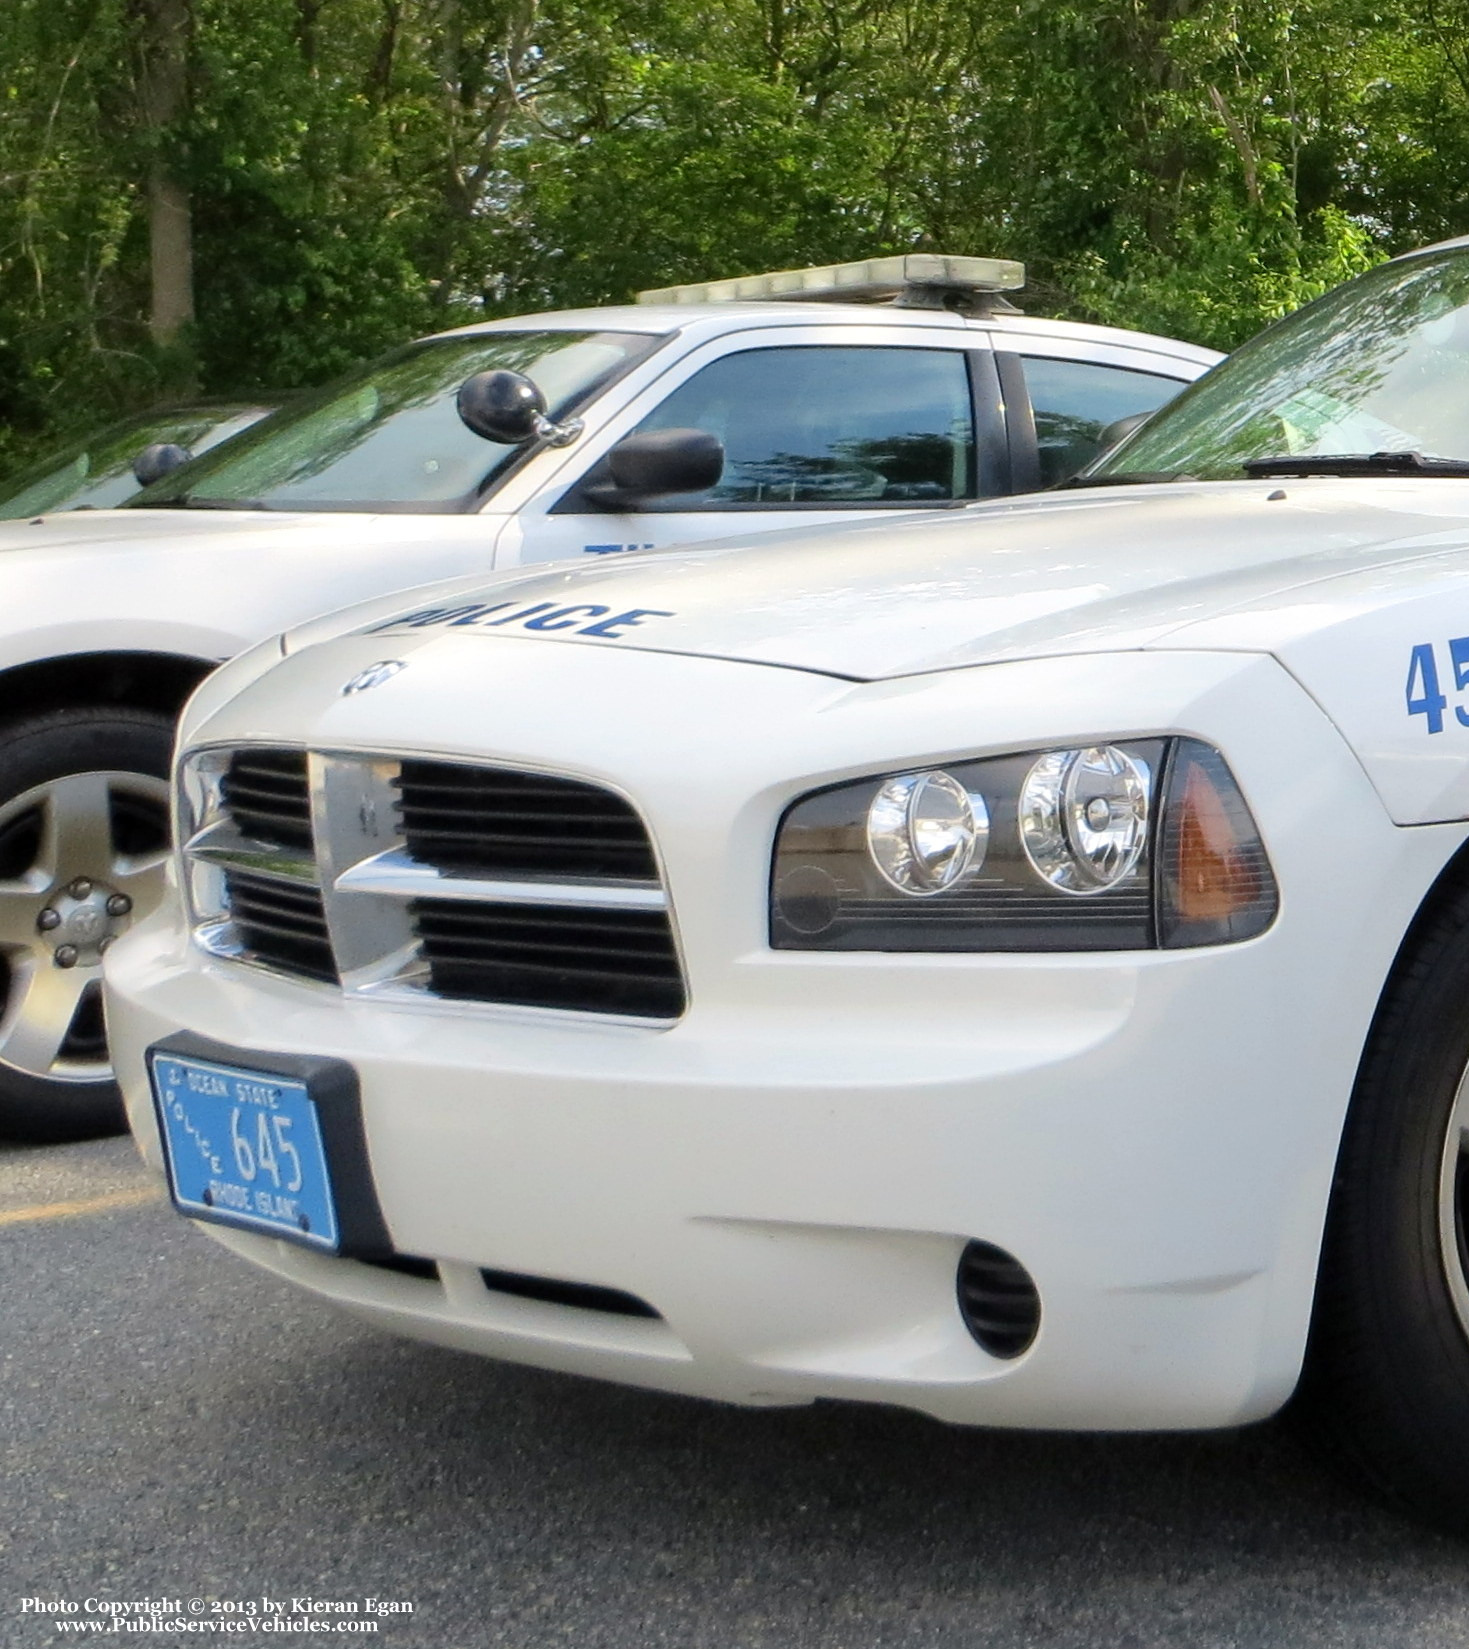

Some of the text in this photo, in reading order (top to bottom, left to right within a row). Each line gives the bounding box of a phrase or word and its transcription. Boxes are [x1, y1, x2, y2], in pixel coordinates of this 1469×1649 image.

[364, 601, 676, 638] POLICE
[187, 1071, 280, 1109] OCEAN STATE
[165, 1090, 223, 1174] POLICE
[231, 1106, 302, 1192] 645
